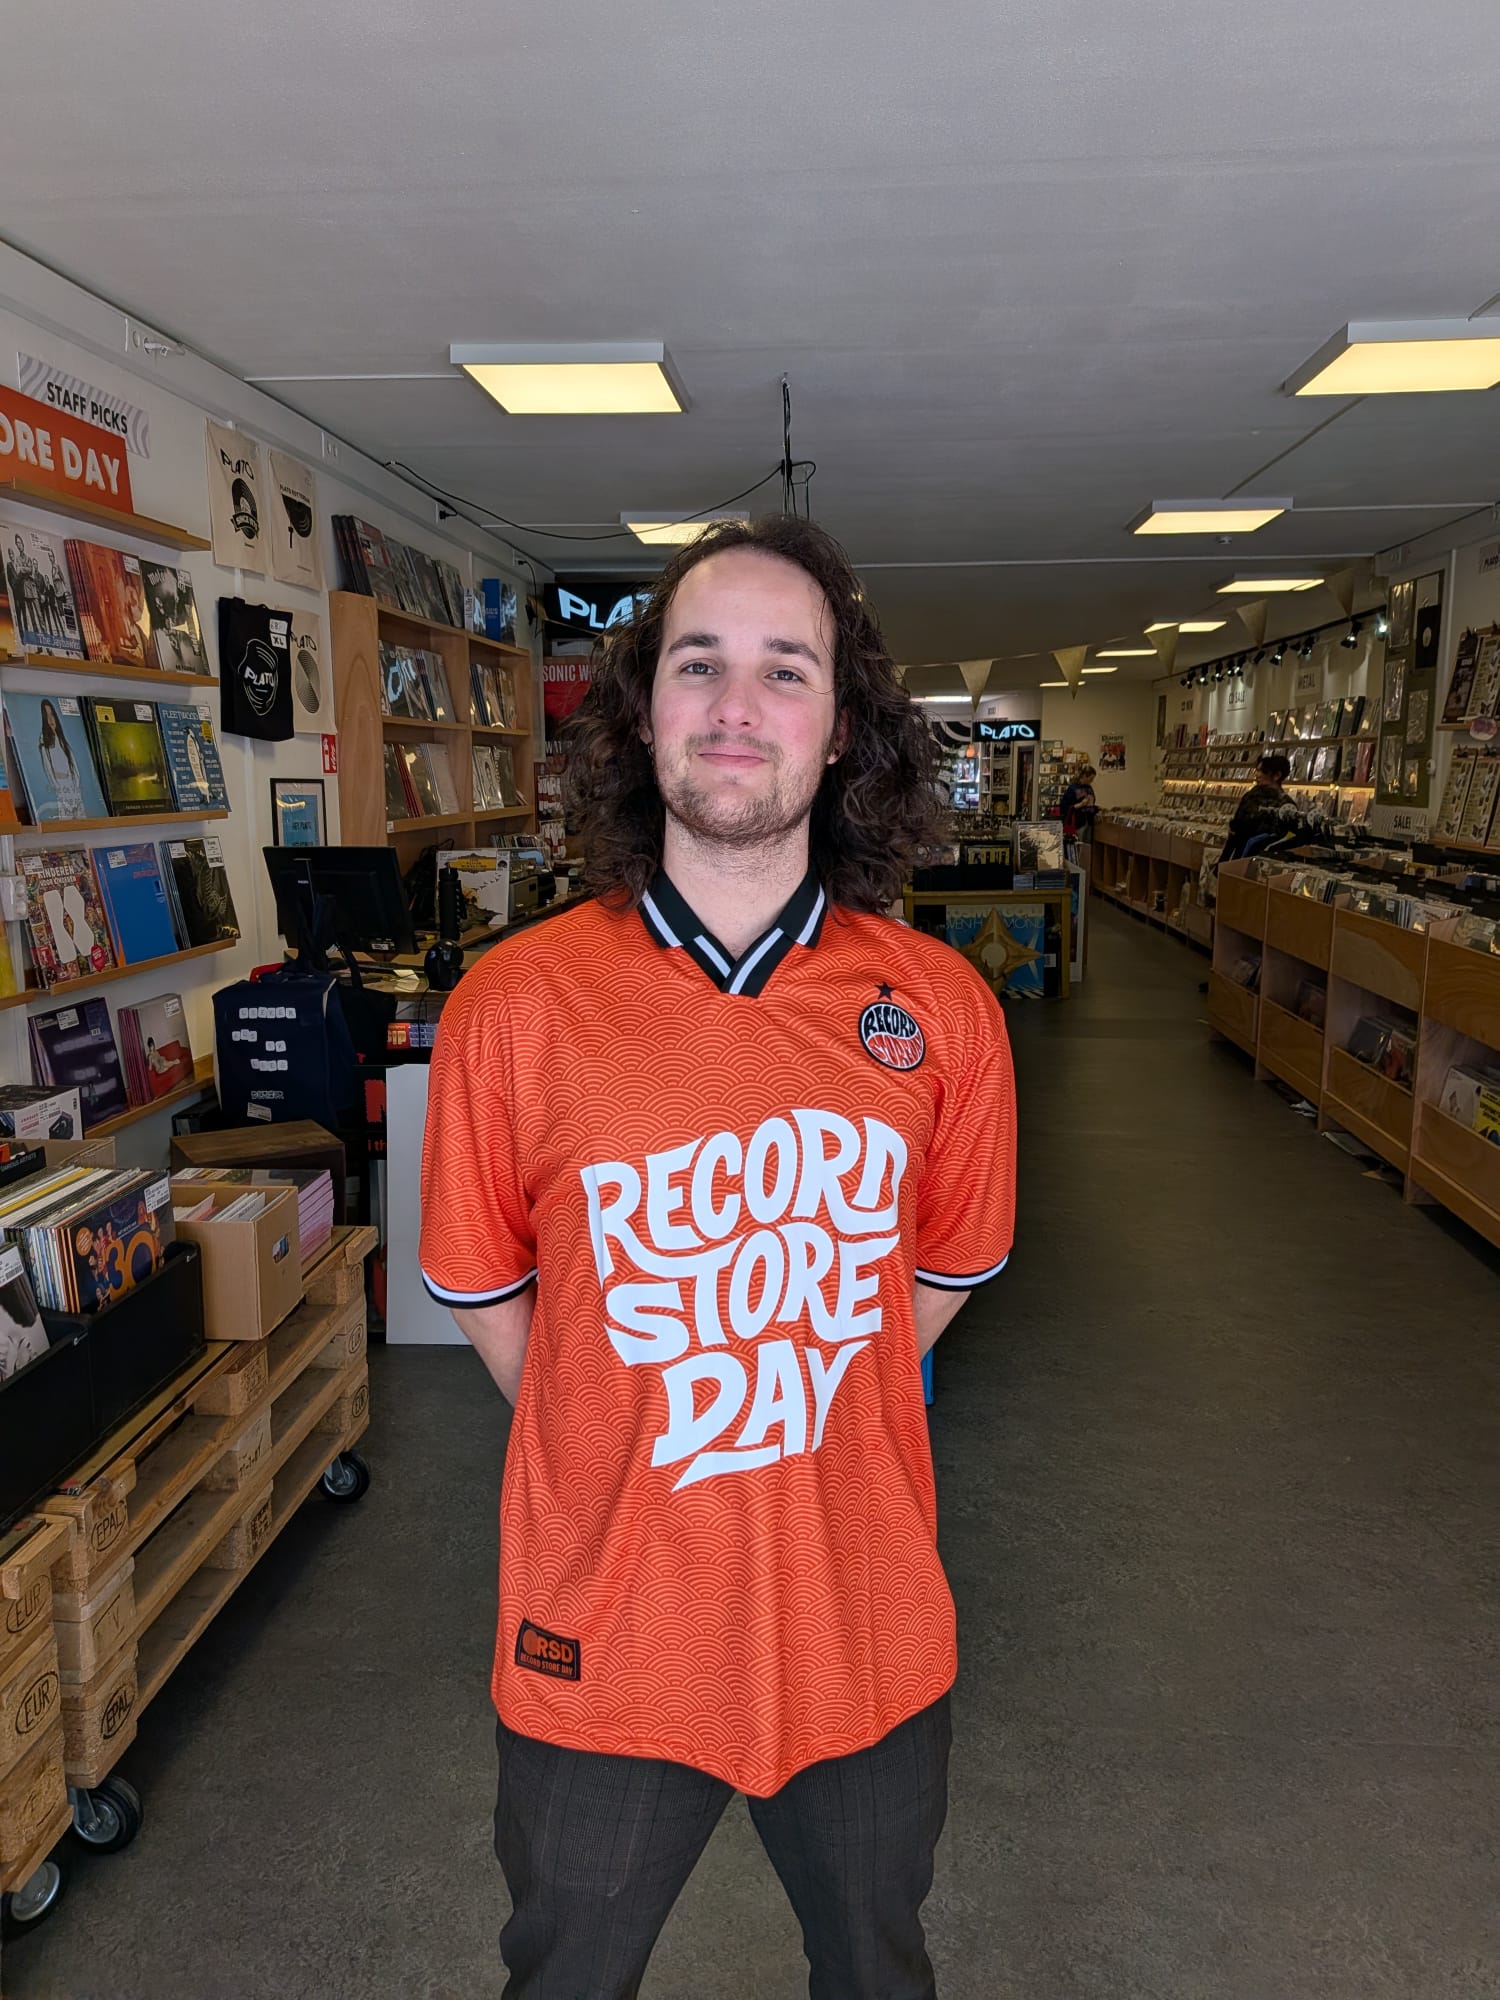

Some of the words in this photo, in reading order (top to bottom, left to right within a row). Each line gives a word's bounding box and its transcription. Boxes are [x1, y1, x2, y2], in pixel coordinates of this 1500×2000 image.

[46, 381, 87, 415] STAFF
[91, 401, 128, 434] PICKS
[60, 437, 120, 496] DAY
[220, 448, 254, 480] PLATO
[272, 636, 285, 647] XL
[244, 666, 275, 688] PLATO
[543, 664, 576, 682] SONIC
[979, 723, 1035, 740] PLATO
[863, 1005, 917, 1041] RECORD
[580, 1109, 908, 1291] RECORD
[104, 1230, 156, 1300] 30
[603, 1222, 900, 1367] STORE
[651, 1340, 871, 1491] DAY
[96, 1512, 124, 1546] EPAL
[15, 1583, 41, 1628] EUR
[520, 1653, 541, 1669] RECORD
[542, 1661, 560, 1673] STORE
[561, 1664, 573, 1676] DAY
[537, 1636, 574, 1664] RSD
[24, 1679, 51, 1728] EUR
[106, 1690, 130, 1733] EPAL
